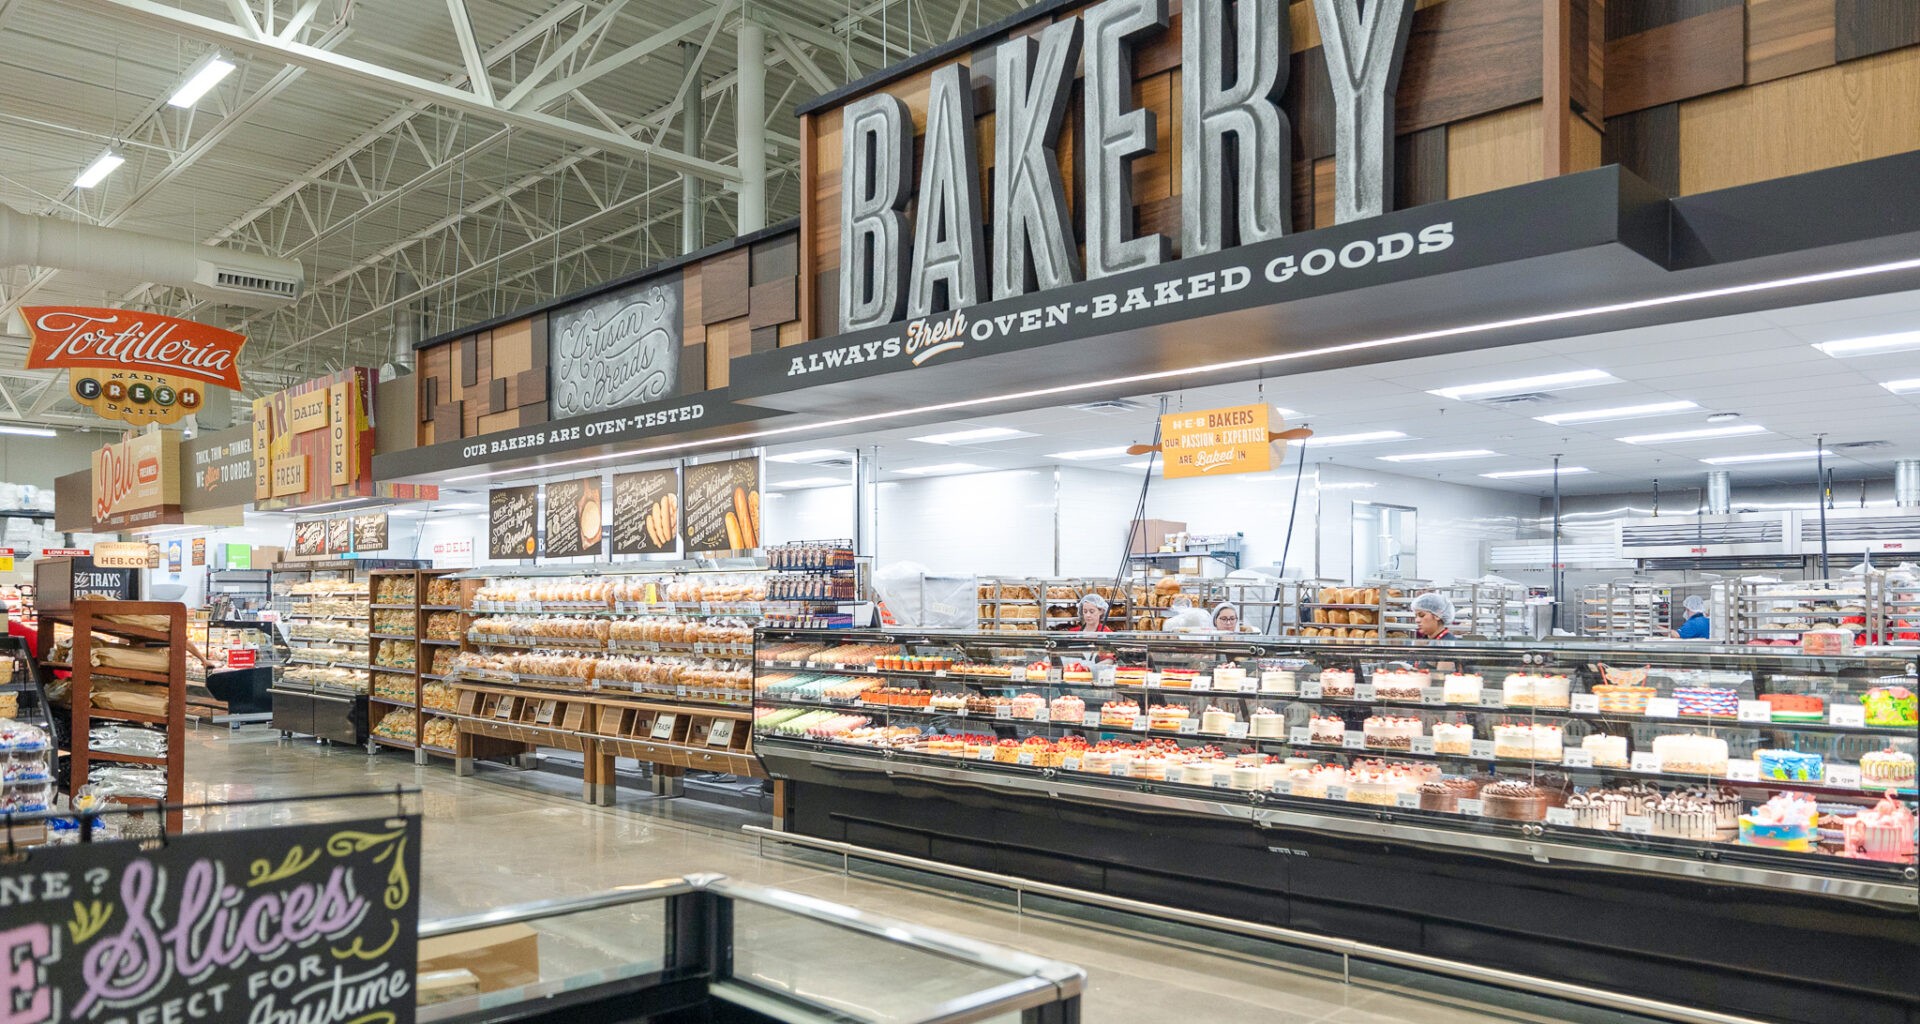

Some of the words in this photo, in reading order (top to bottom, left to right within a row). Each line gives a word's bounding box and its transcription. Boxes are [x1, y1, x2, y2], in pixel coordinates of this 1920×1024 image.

[839, 0, 1417, 335] BAKERY
[788, 337, 901, 377] ALWAYS
[905, 309, 968, 354] Fresh
[1264, 221, 1456, 282] GOODS
[561, 302, 647, 374] Artisan
[111, 372, 166, 384] MADE
[582, 346, 656, 409] Breads
[85, 381, 195, 404] FRESH
[106, 403, 171, 415] DAILY
[294, 402, 323, 420] DAILY
[1208, 410, 1254, 427] BAKERS
[334, 394, 343, 474] FLOUR
[463, 444, 487, 458] OUR
[491, 432, 545, 452] BAKERS
[550, 425, 581, 443] ARE
[1165, 438, 1180, 448] OUR
[1181, 431, 1214, 449] PASSION
[1215, 434, 1221, 443] &
[1223, 427, 1266, 444] EXPERTISE
[196, 450, 211, 465] THICK,
[211, 446, 222, 460] THIN
[229, 439, 253, 456] THINNER.
[258, 420, 266, 486] MADE
[1178, 455, 1193, 465] ARE
[1195, 449, 1234, 467] Baked
[1238, 450, 1246, 460] IN
[96, 432, 134, 524] Deli
[196, 471, 205, 488] WE
[221, 466, 228, 482] TO
[230, 461, 253, 480] ORDER.
[276, 464, 301, 486] FRESH
[446, 541, 470, 552] DELI
[89, 573, 120, 587] TRAYS
[657, 722, 671, 731] TRASH
[713, 729, 729, 738] TRASH
[71, 859, 365, 1019] Slices
[248, 955, 325, 1000] FOR
